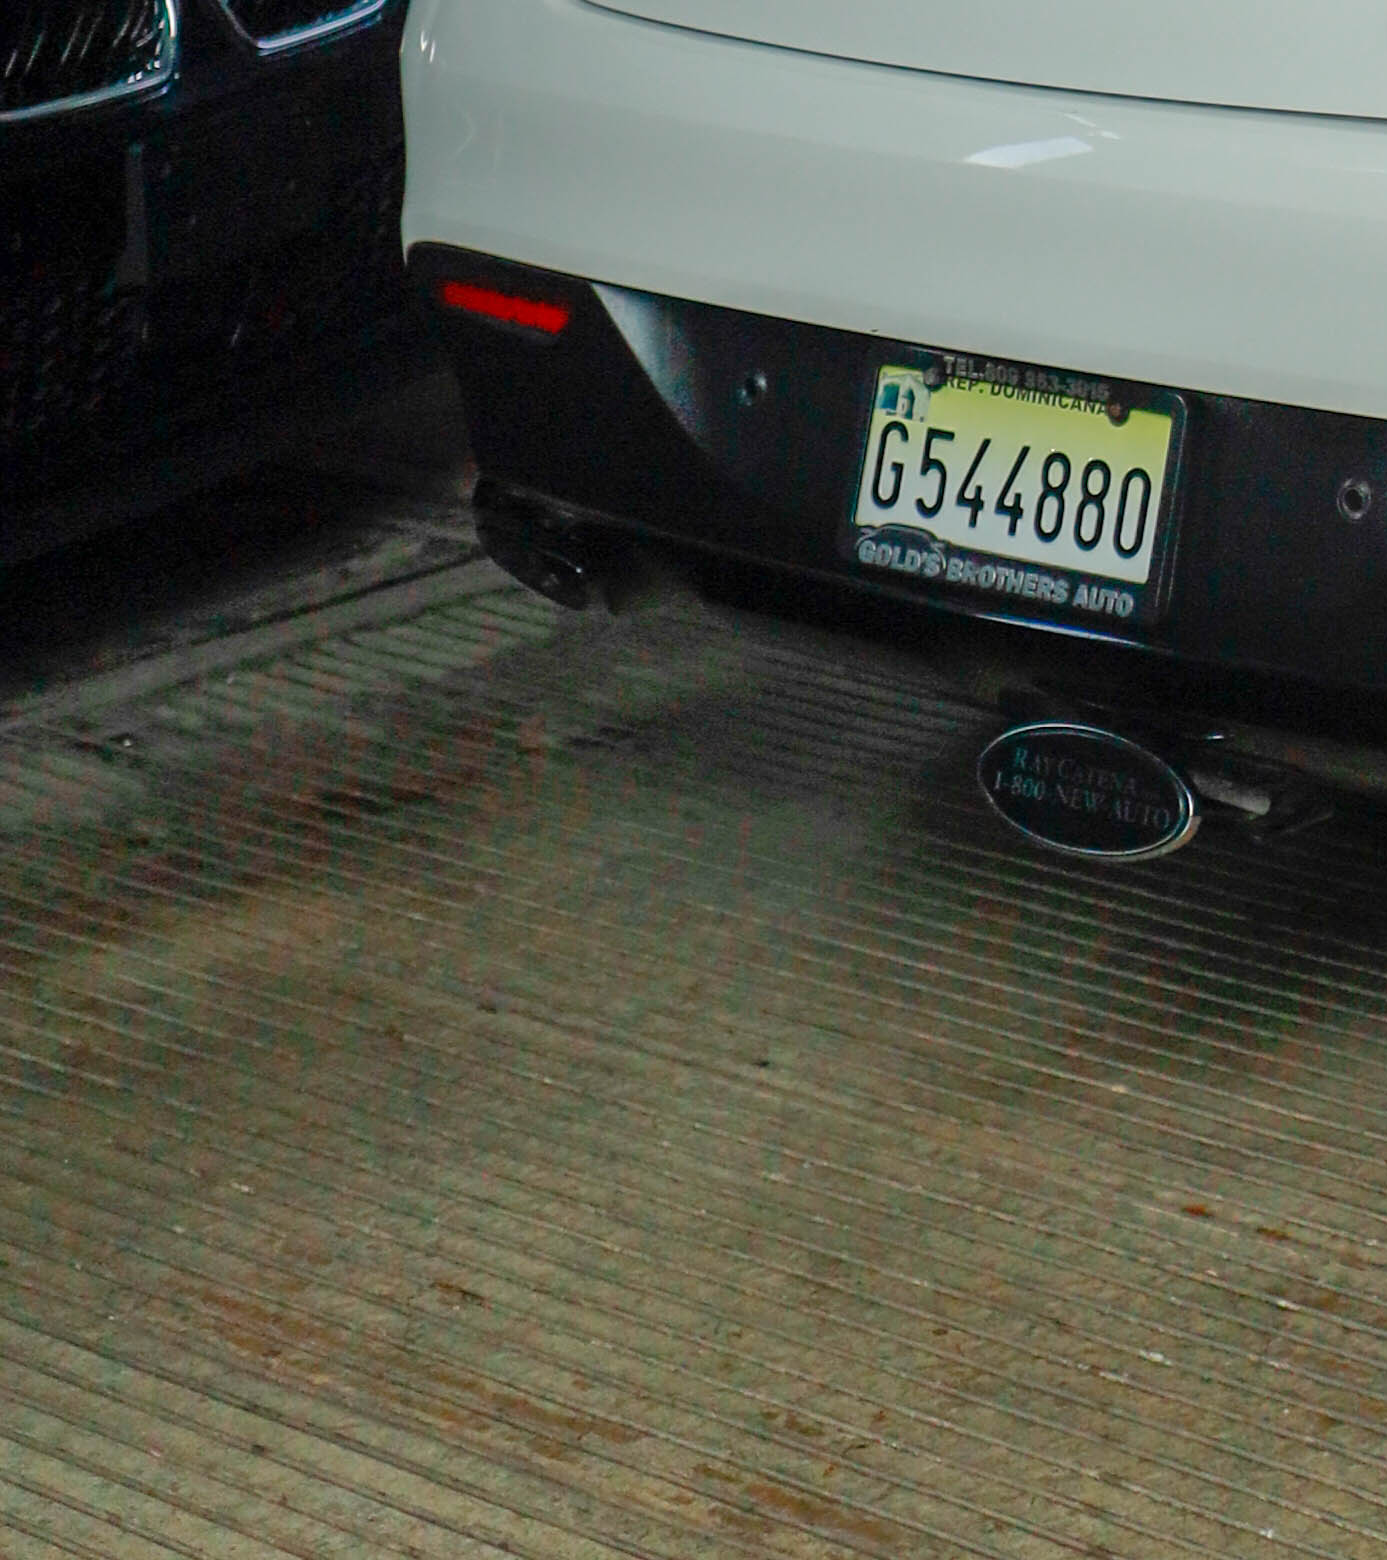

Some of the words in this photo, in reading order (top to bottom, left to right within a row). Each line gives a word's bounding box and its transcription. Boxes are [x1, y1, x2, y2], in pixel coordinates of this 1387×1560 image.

[989, 383, 1108, 417] DOMINICANA
[871, 421, 1152, 560] G544880
[858, 539, 942, 578] GOLD'S
[946, 557, 1070, 605] BROTHERS
[1072, 584, 1135, 618] AUTO
